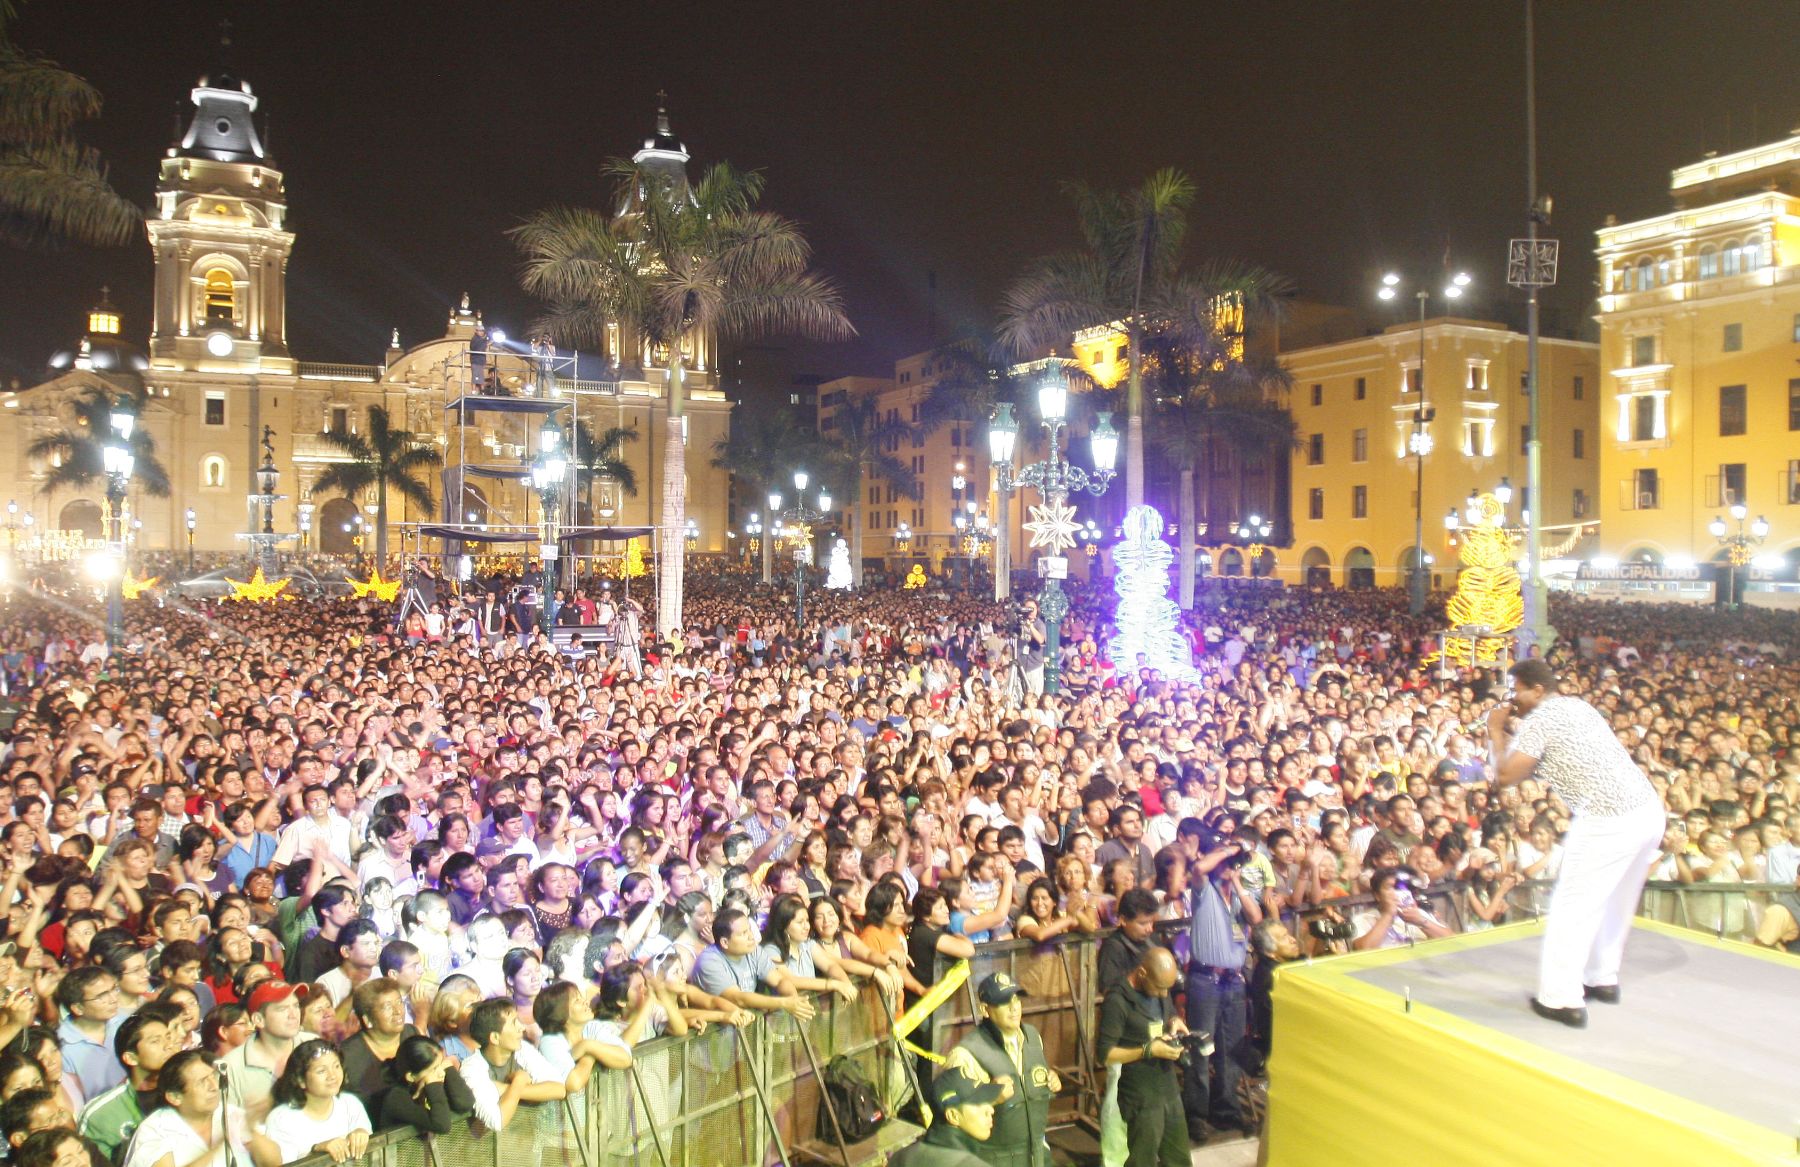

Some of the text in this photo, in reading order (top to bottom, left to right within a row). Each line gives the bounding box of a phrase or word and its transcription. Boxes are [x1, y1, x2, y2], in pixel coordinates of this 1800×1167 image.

[44, 529, 83, 541] FELIZ
[42, 549, 80, 561] LIMA
[1581, 565, 1774, 580] MUNICIPALIDAD DE
